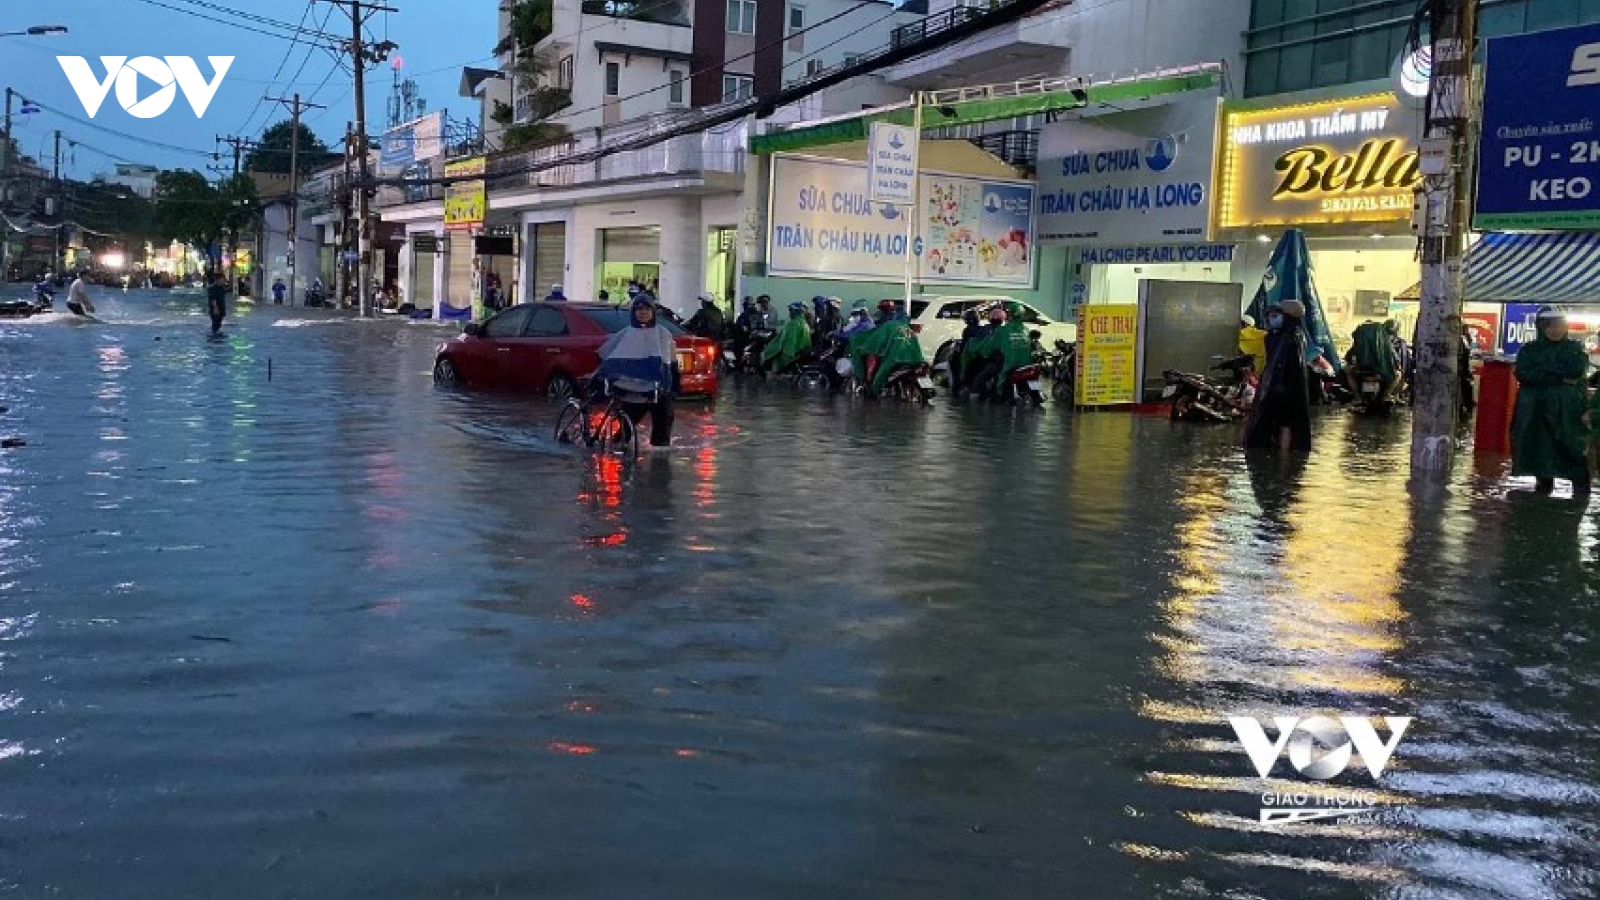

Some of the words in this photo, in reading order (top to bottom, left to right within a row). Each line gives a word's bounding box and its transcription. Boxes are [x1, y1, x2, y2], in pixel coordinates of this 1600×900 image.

[1266, 119, 1306, 142] KHOA
[1271, 138, 1422, 200] Bella
[1504, 145, 1542, 168] PU
[1128, 186, 1150, 214] HẠ
[1156, 182, 1204, 208] LONG
[1529, 176, 1592, 201] KEO
[863, 232, 882, 258] HẠ
[1081, 248, 1098, 264] HA
[1099, 247, 1135, 263] LONG
[1135, 245, 1175, 262] PEARL
[1177, 243, 1235, 262] YOGURT
